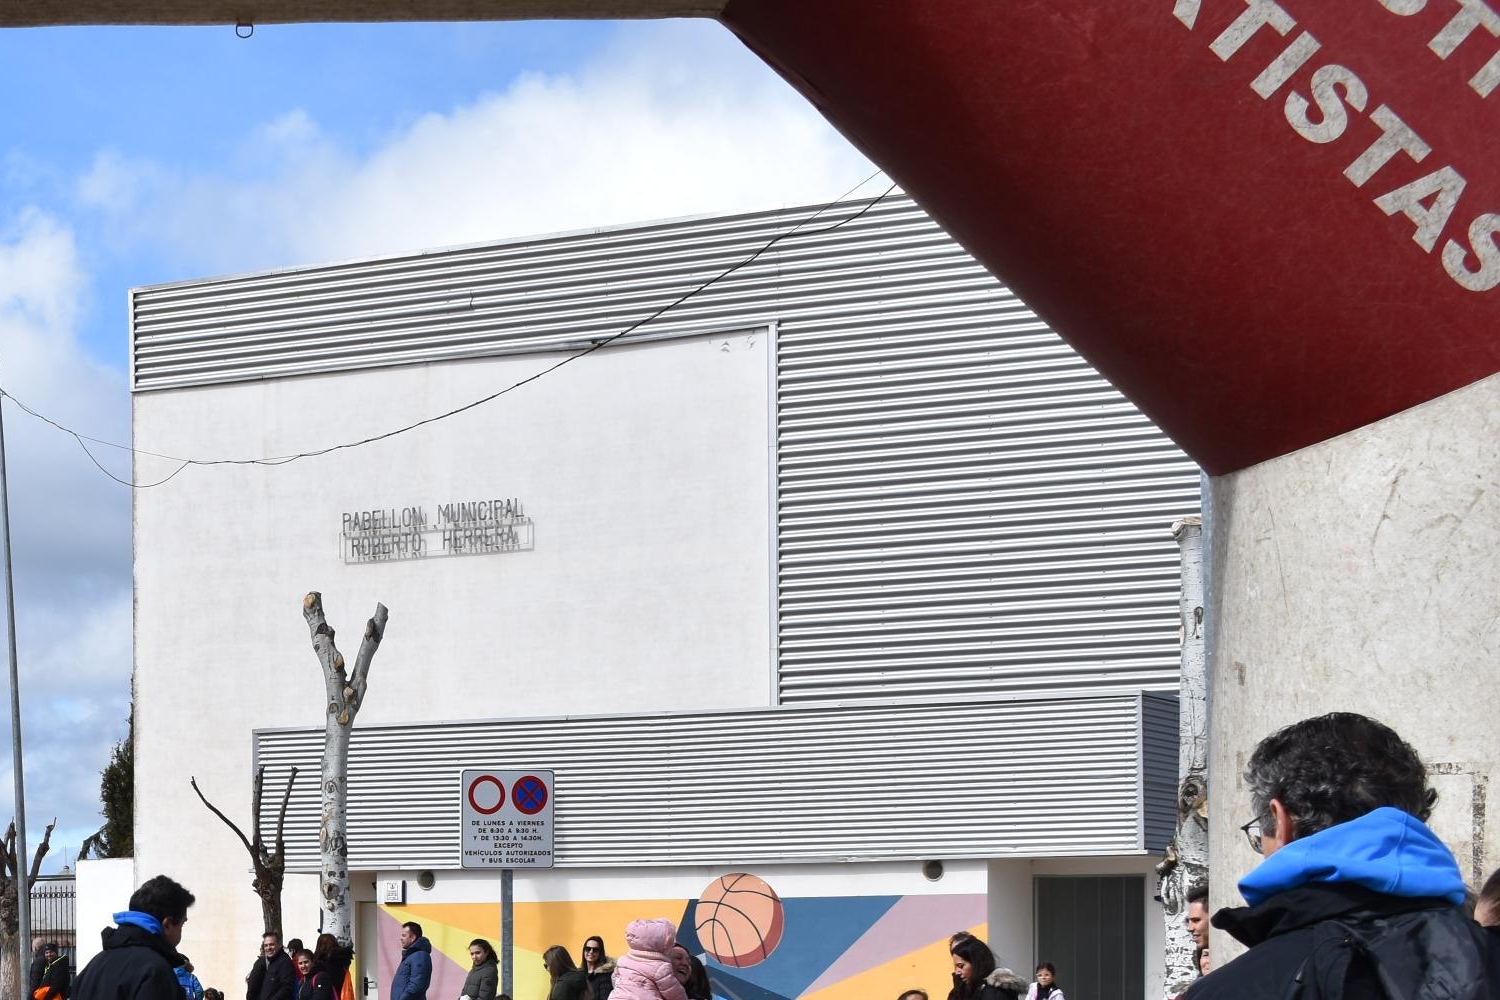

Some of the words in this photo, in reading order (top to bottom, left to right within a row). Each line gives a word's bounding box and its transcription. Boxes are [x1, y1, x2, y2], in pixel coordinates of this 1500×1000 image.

[1172, 0, 1500, 292] TISTAS
[437, 497, 525, 525] MUNICIPAL
[351, 532, 422, 557] ROBERTO
